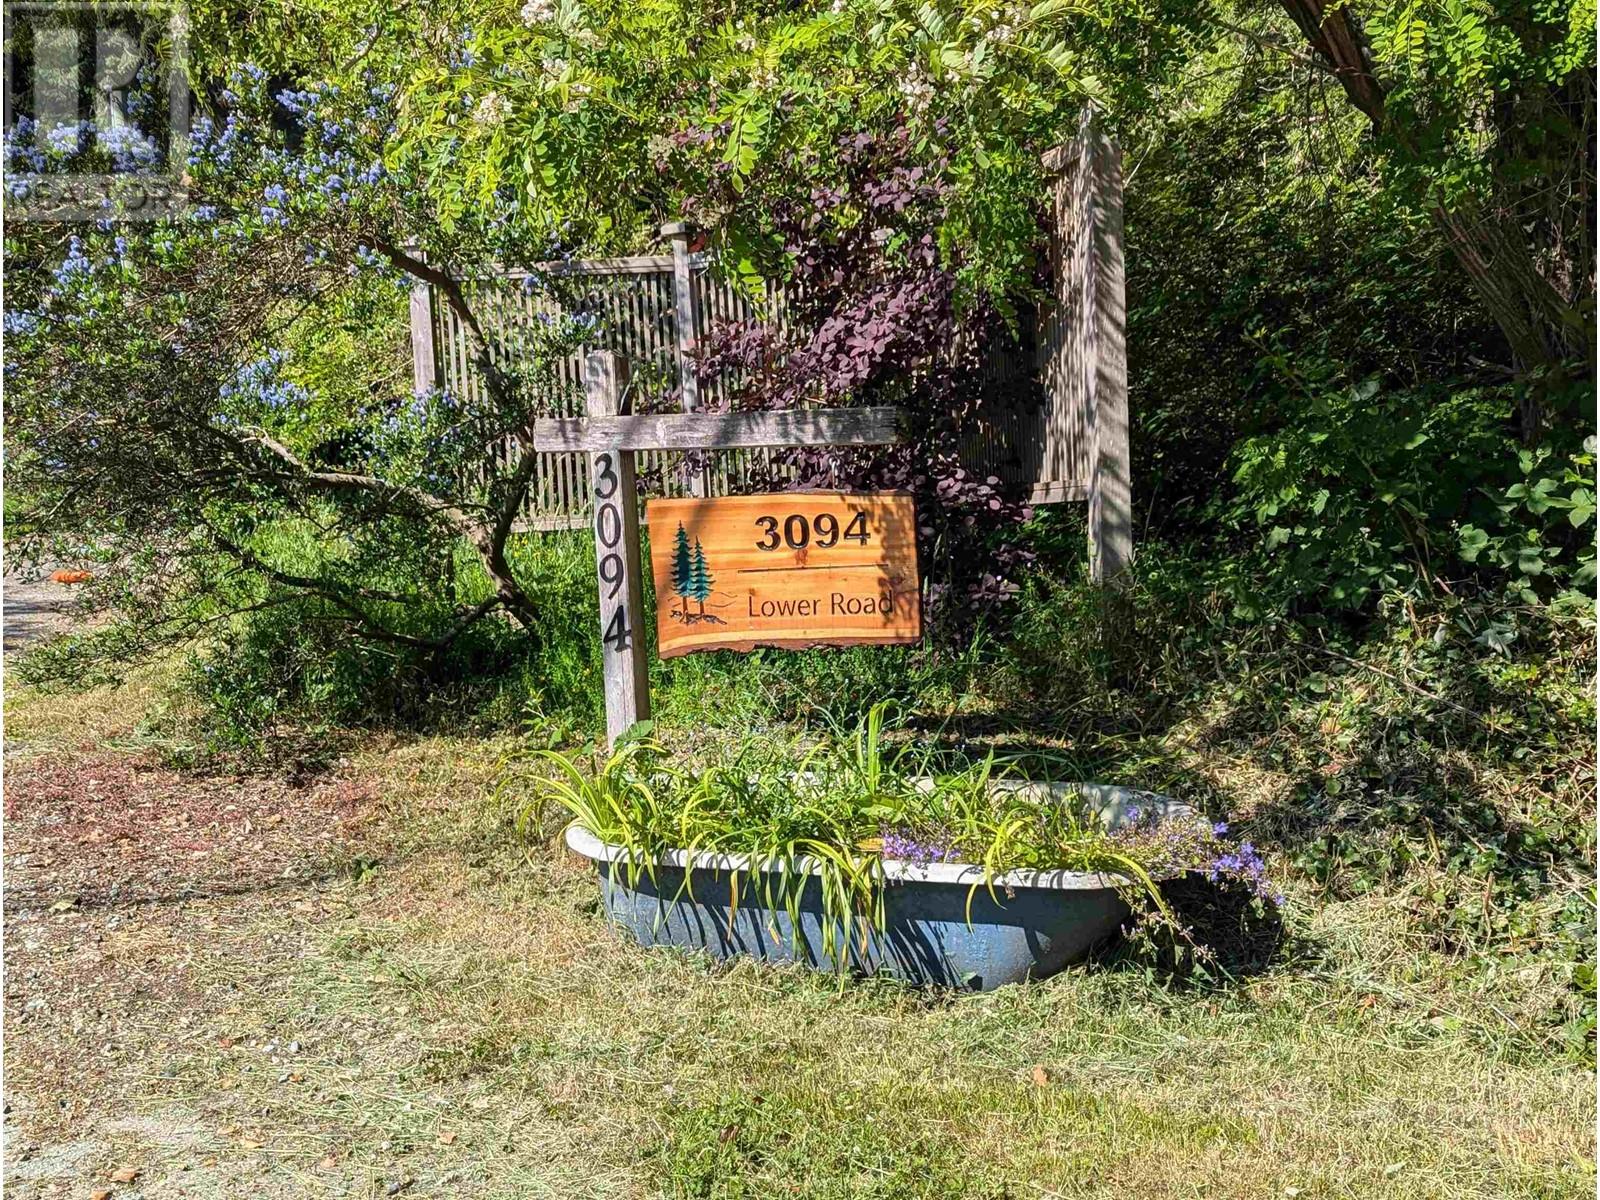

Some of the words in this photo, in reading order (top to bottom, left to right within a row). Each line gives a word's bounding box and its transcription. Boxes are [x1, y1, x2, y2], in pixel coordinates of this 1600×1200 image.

[755, 511, 871, 551] 3094
[594, 453, 632, 652] 3094
[748, 594, 821, 617] Lower
[831, 592, 894, 615] Road
